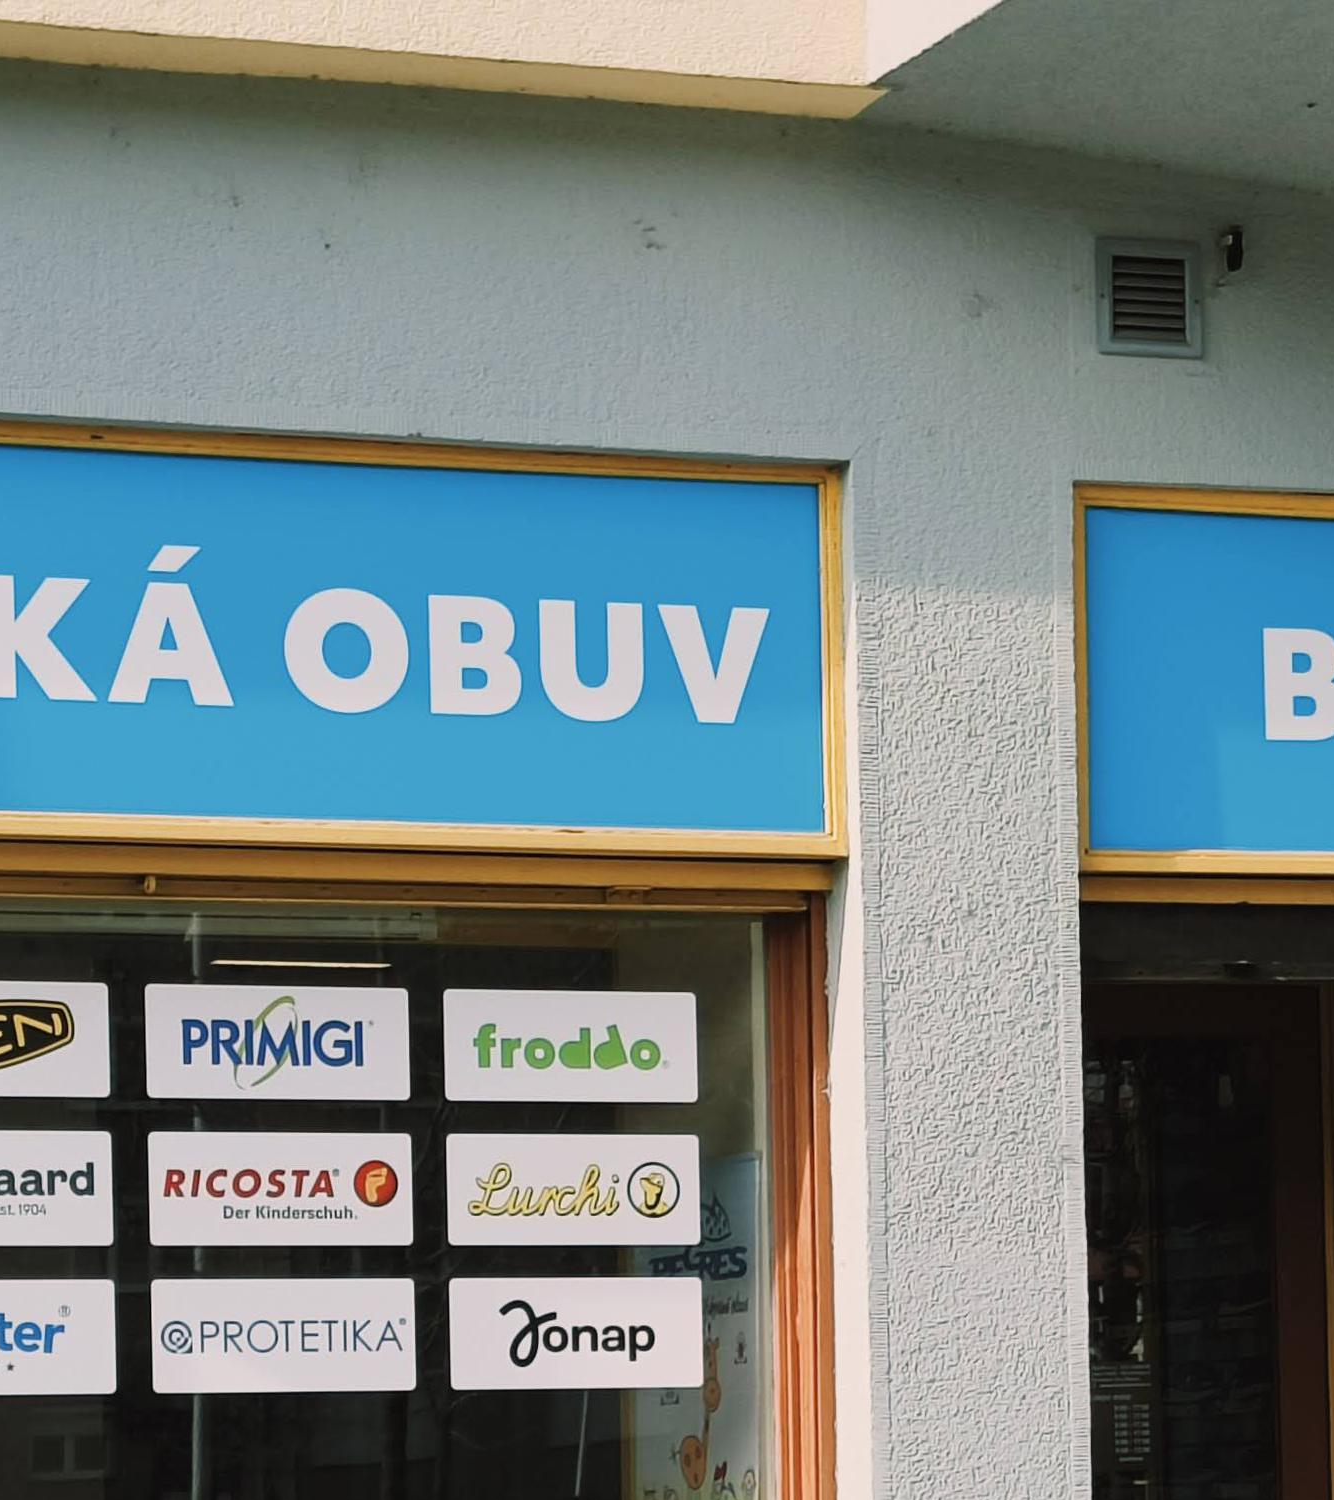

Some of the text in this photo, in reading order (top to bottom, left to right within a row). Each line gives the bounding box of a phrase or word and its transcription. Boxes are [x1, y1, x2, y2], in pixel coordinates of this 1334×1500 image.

[281, 586, 770, 724] OBUV
[180, 1017, 365, 1069] PRIMIGI
[472, 1023, 662, 1071] froddo
[163, 1166, 336, 1199] RICOSTA
[468, 1161, 621, 1218] Lurchi
[17, 1202, 47, 1216] 1904
[222, 1205, 250, 1220] Der
[199, 1317, 404, 1354] PROTETIKA
